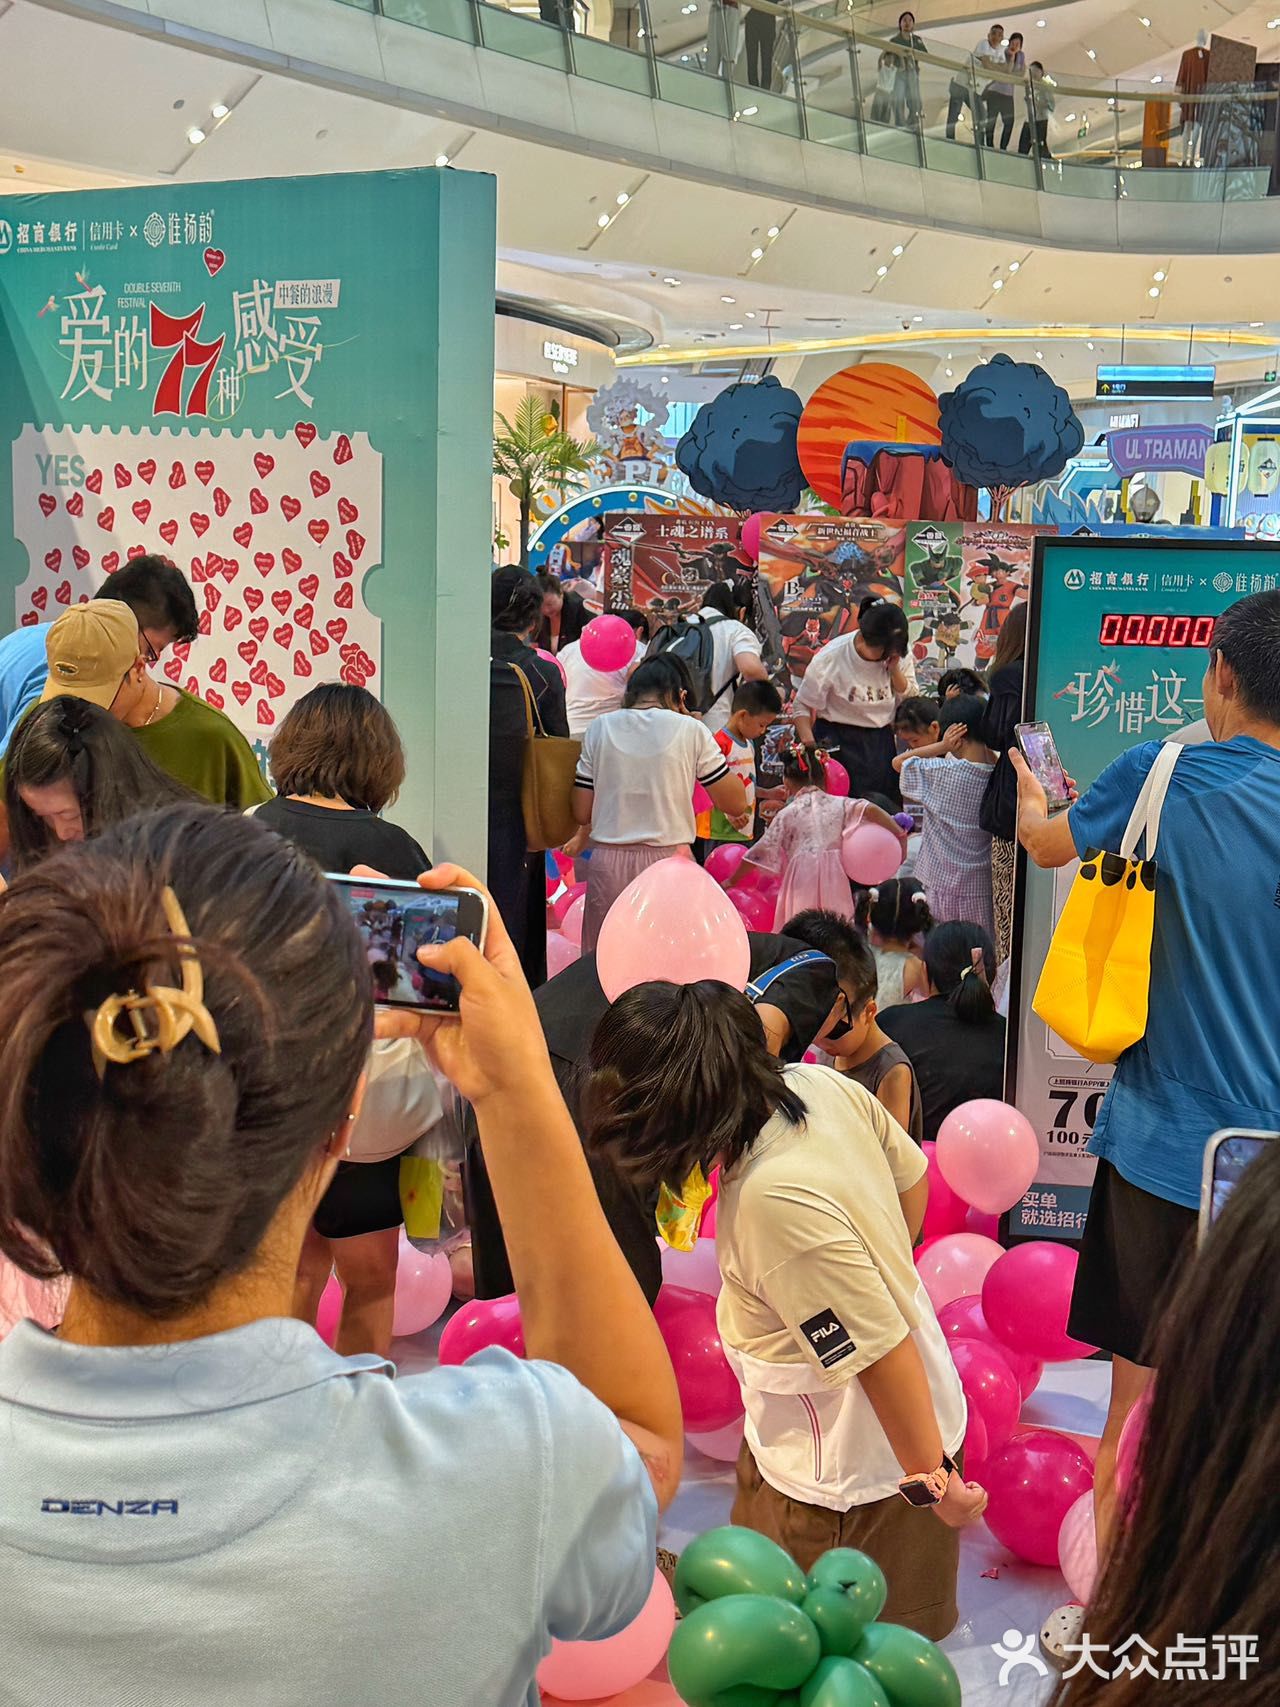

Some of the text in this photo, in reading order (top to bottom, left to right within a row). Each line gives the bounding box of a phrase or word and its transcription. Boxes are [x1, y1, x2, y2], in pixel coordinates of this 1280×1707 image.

[17, 221, 78, 244] 招商银行
[90, 221, 124, 241] 信用卡
[124, 281, 181, 294] DOUBLE SEVENTH
[278, 283, 333, 306] 中餐的浪漫
[117, 298, 146, 308] FESTIVAL
[35, 454, 85, 487] YES
[655, 524, 729, 539] 士魂之谱系
[1089, 571, 1149, 587] 招商银行
[1161, 574, 1194, 587] 信用卡
[1022, 1191, 1057, 1209] 买单
[1021, 1209, 1088, 1230] 就选招行
[810, 1322, 839, 1343] FILA
[41, 1499, 178, 1515] DENZA
